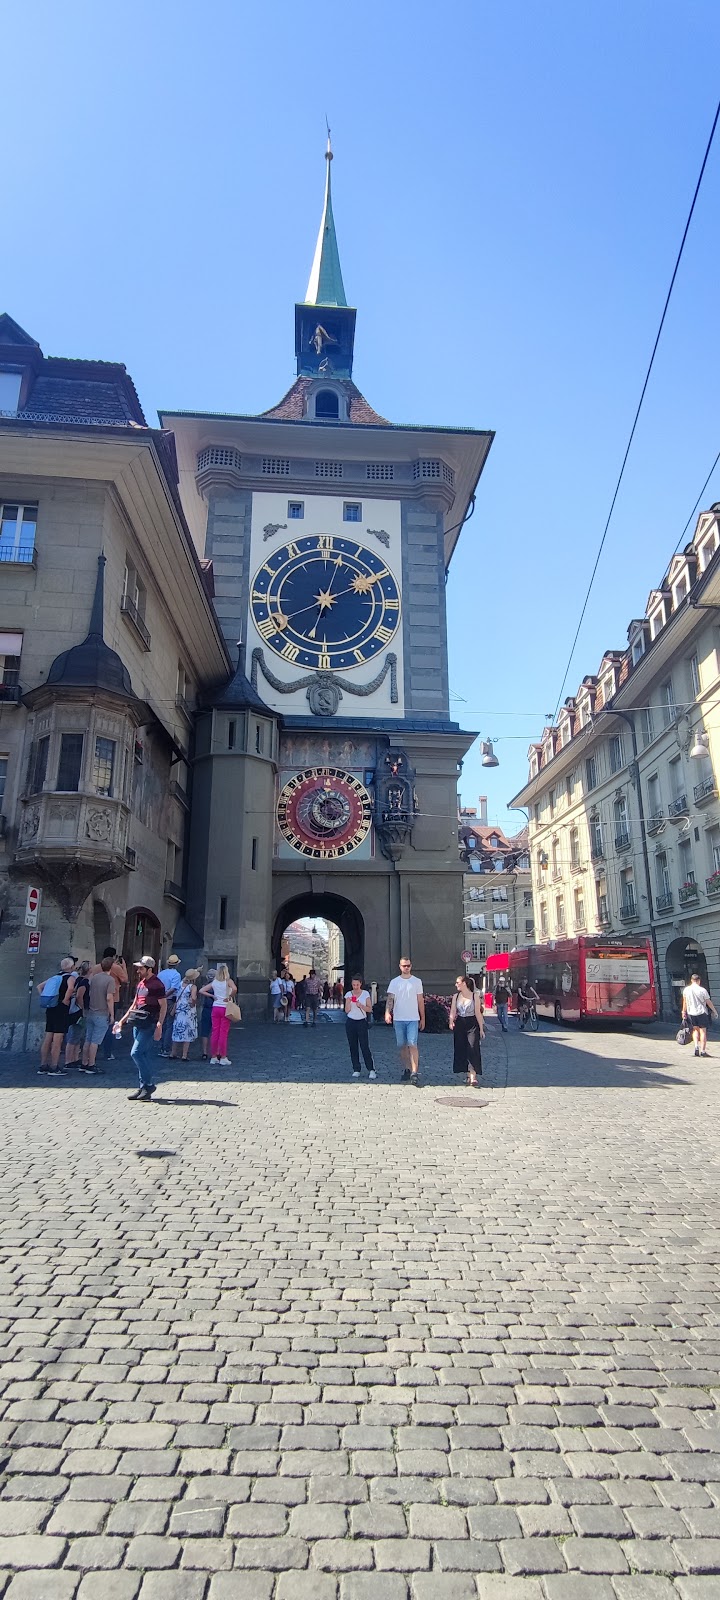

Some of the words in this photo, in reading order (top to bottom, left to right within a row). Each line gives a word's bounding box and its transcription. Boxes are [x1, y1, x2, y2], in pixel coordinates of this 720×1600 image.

[317, 536, 334, 549] XII
[285, 542, 301, 558] XI
[384, 598, 399, 610] III
